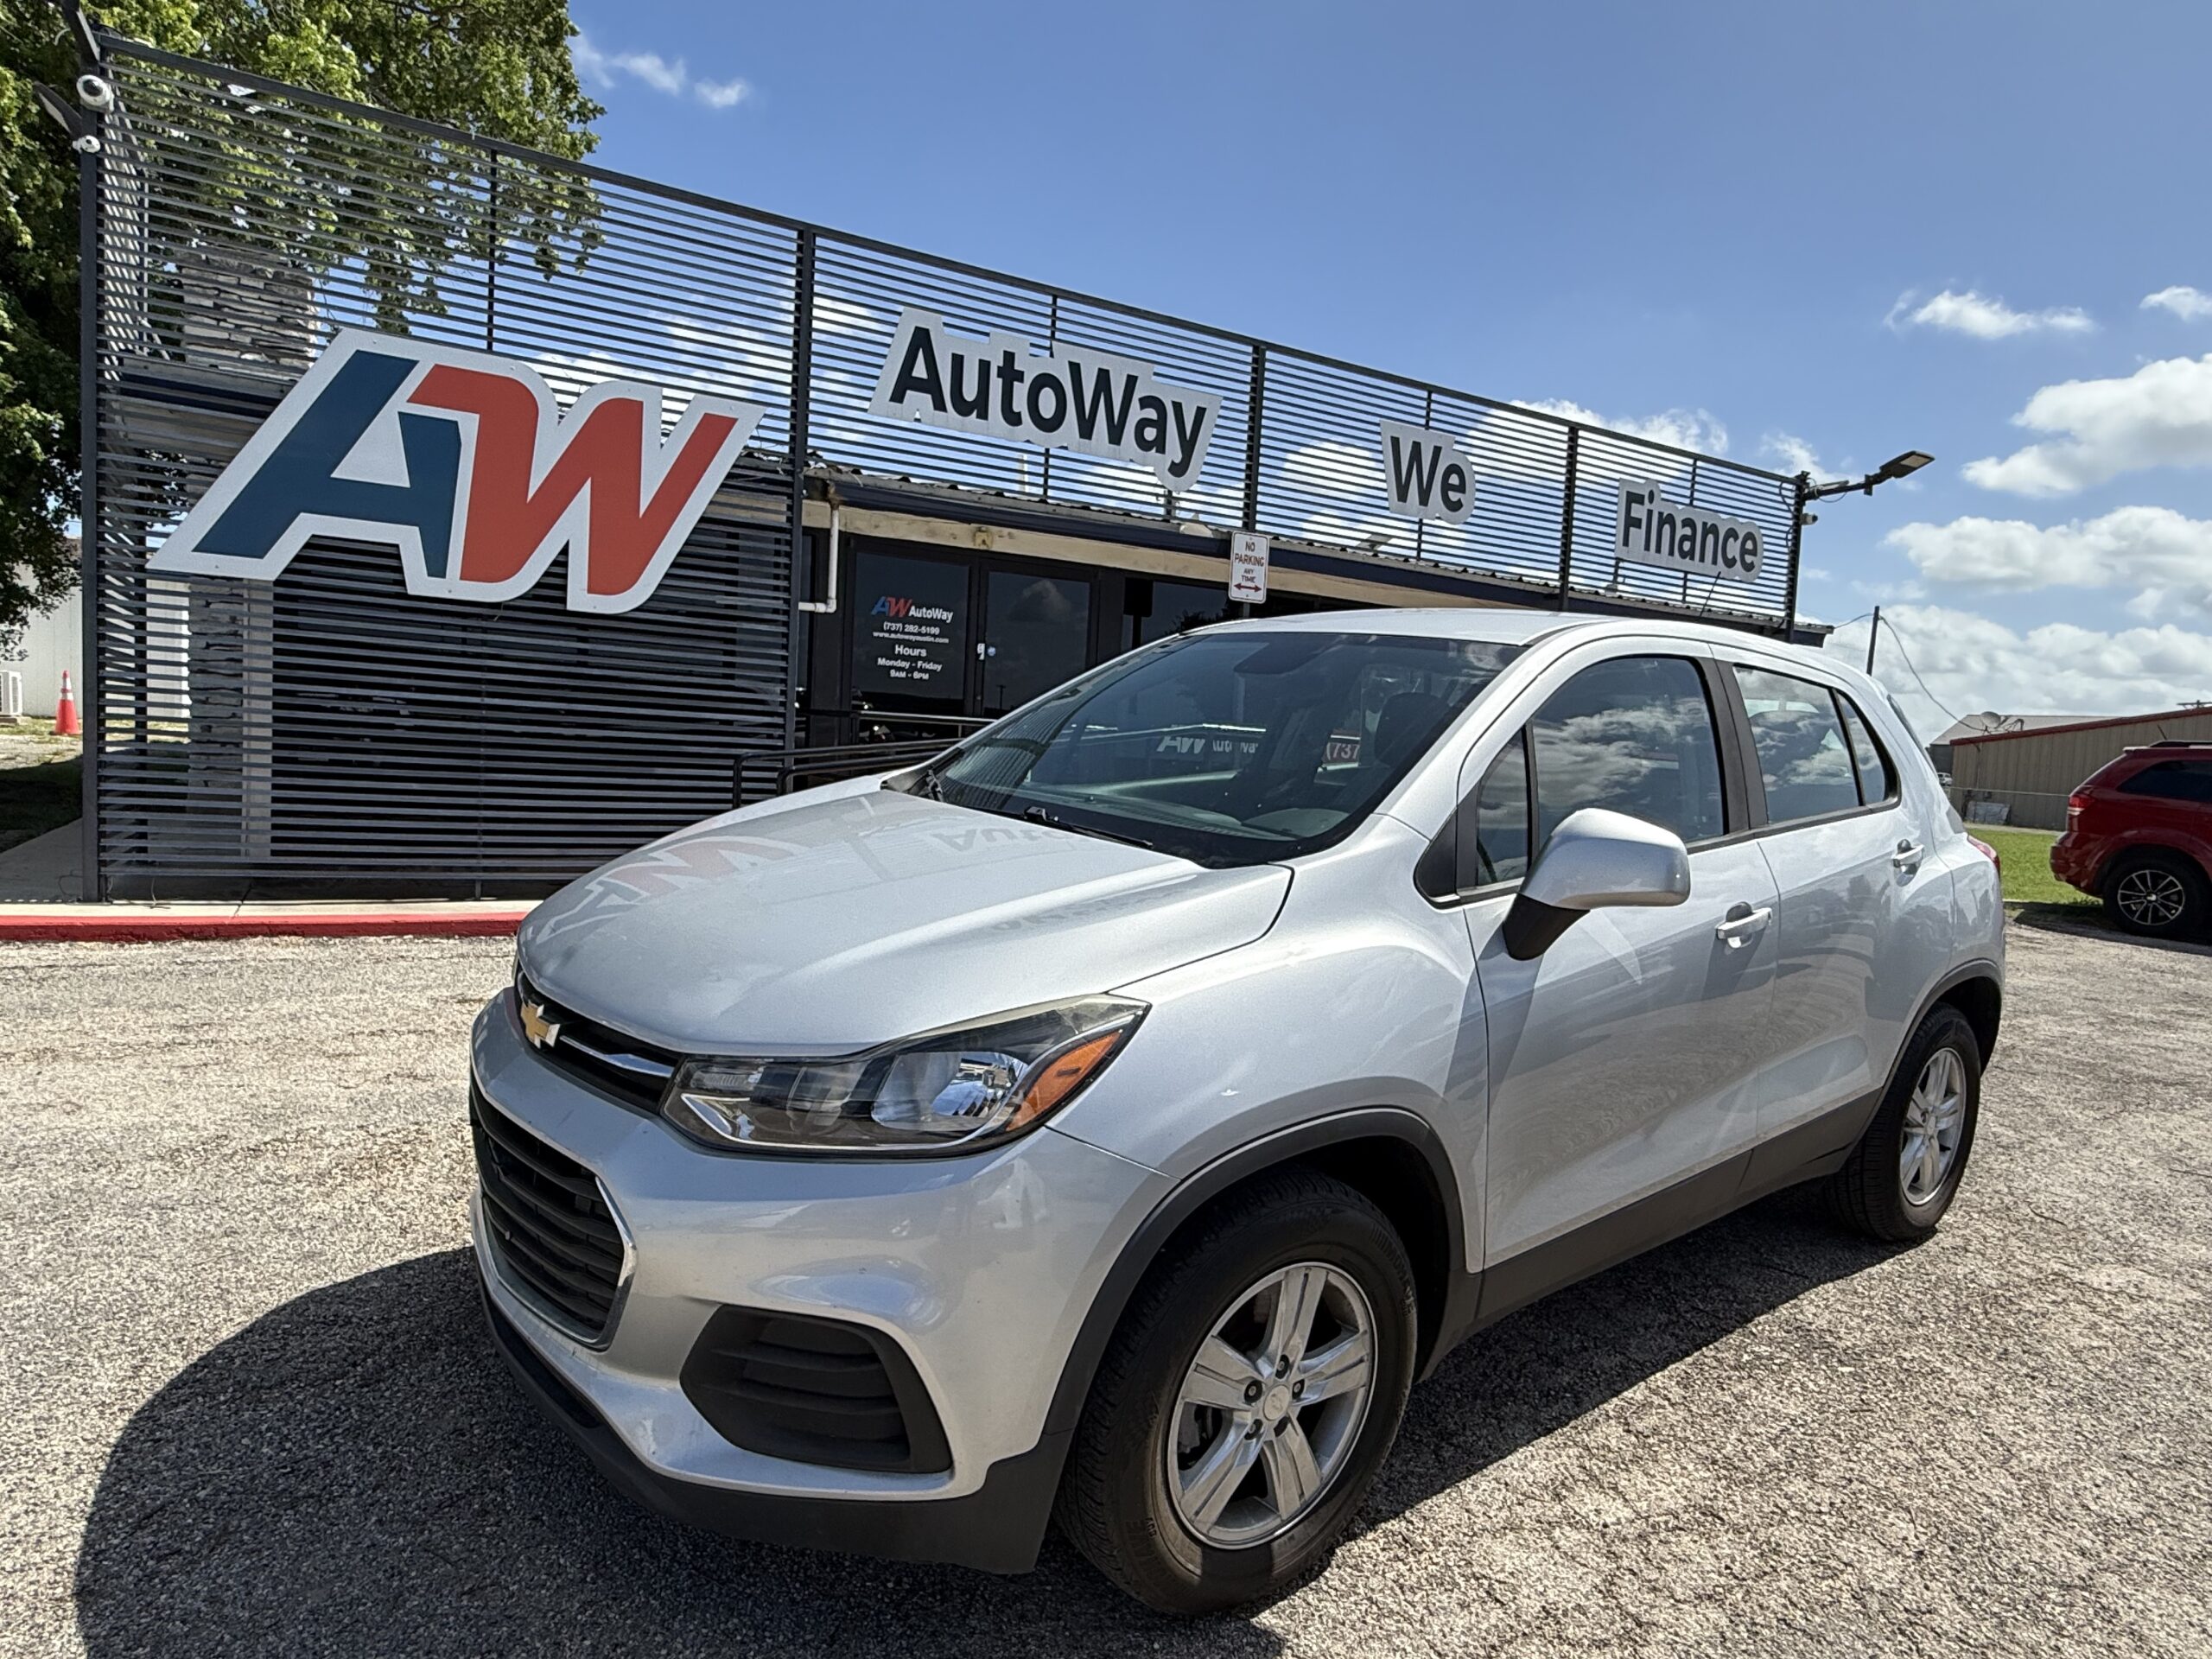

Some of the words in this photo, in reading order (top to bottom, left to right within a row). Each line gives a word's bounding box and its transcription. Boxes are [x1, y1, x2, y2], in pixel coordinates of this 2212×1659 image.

[889, 326, 1207, 478] AutoWay
[1389, 435, 1467, 512] We
[1621, 489, 1759, 573] Finance
[192, 349, 738, 596] AW
[1245, 541, 1255, 552] NO
[1234, 553, 1265, 567] PARKING
[1241, 575, 1256, 583] TIME
[871, 596, 912, 618] AW
[908, 606, 954, 623] AutoWay
[883, 621, 903, 632] (737)
[904, 624, 940, 635] 282-5199
[894, 644, 927, 657] Hours
[877, 657, 911, 669] Monday
[917, 661, 943, 672] Friday
